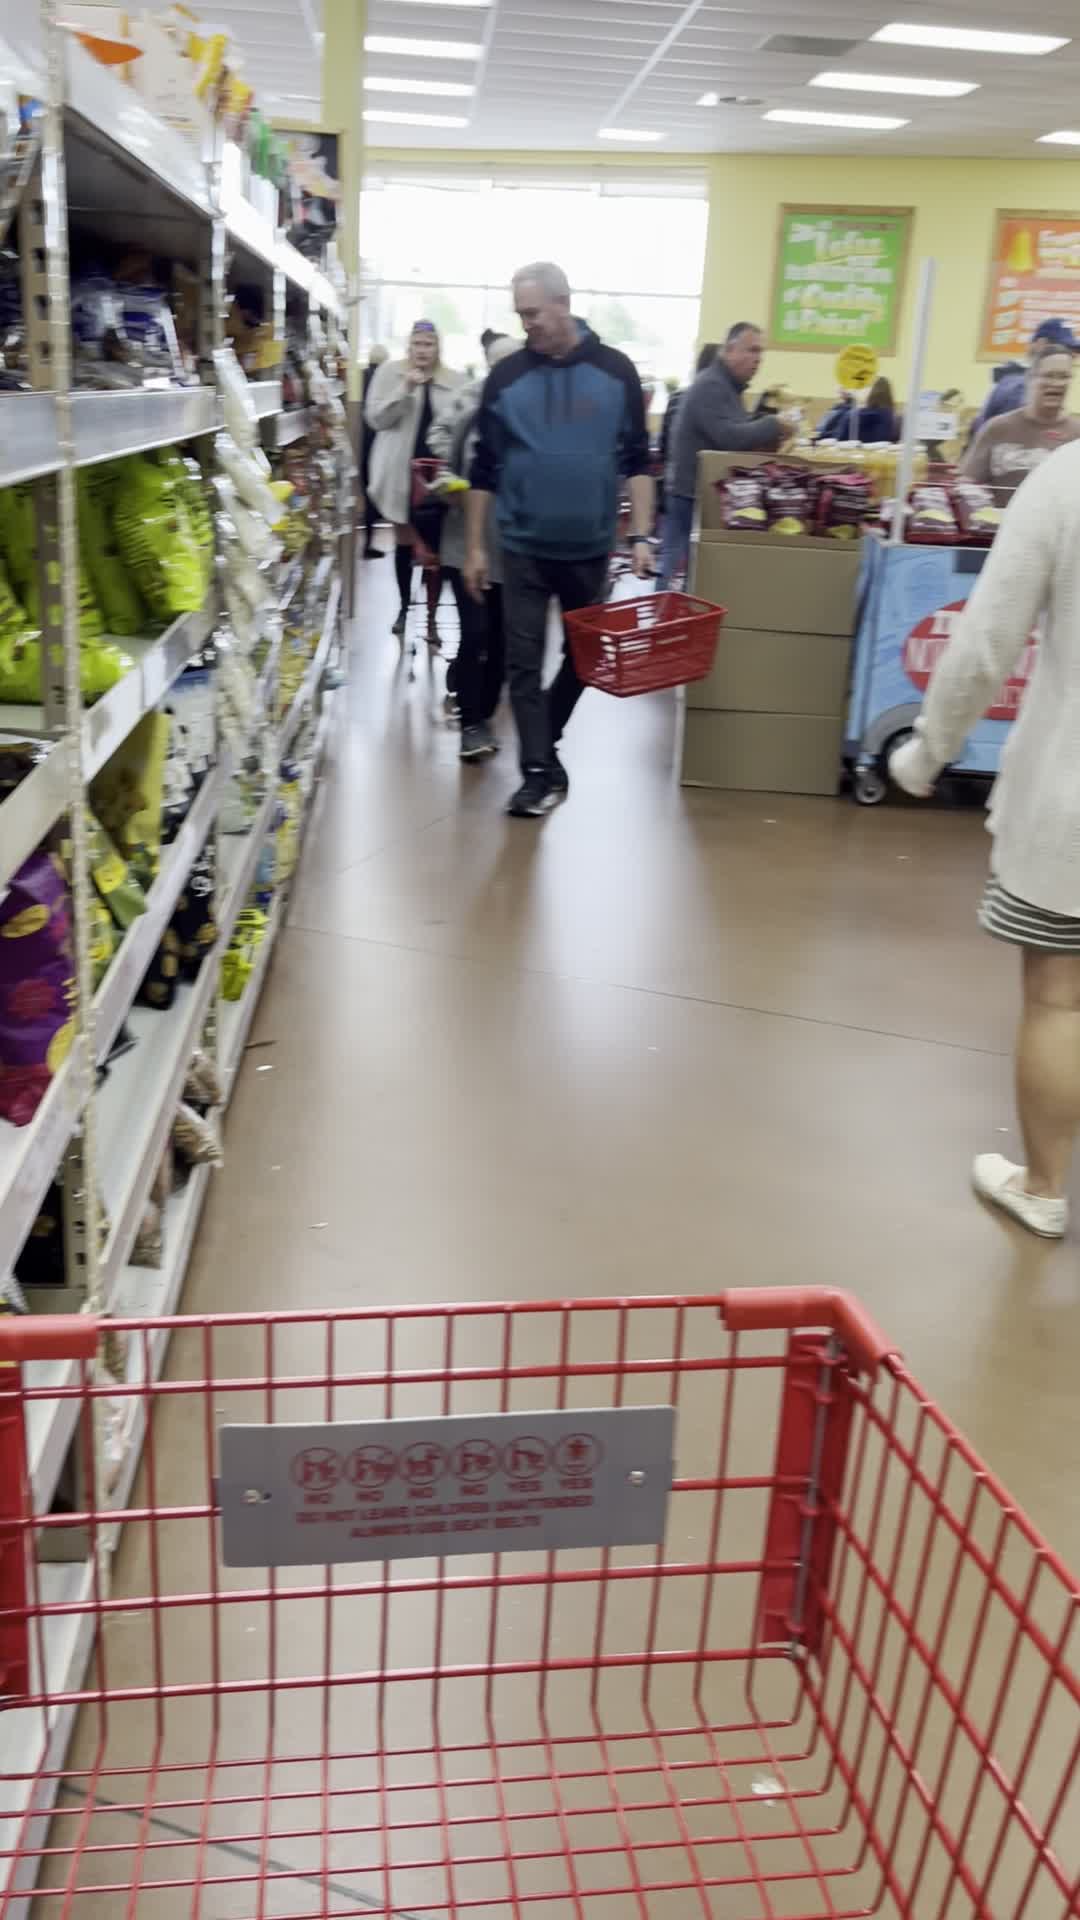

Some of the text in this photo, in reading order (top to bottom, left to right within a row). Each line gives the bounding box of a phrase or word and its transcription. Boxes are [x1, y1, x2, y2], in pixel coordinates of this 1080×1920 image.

[304, 1477, 592, 1504] NO NO NO NO YES YES
[296, 1495, 592, 1523] DO NOT LEAVE CHILDREN UNATTENDED
[350, 1515, 540, 1537] ALWAYS USE SEAT BELTS
